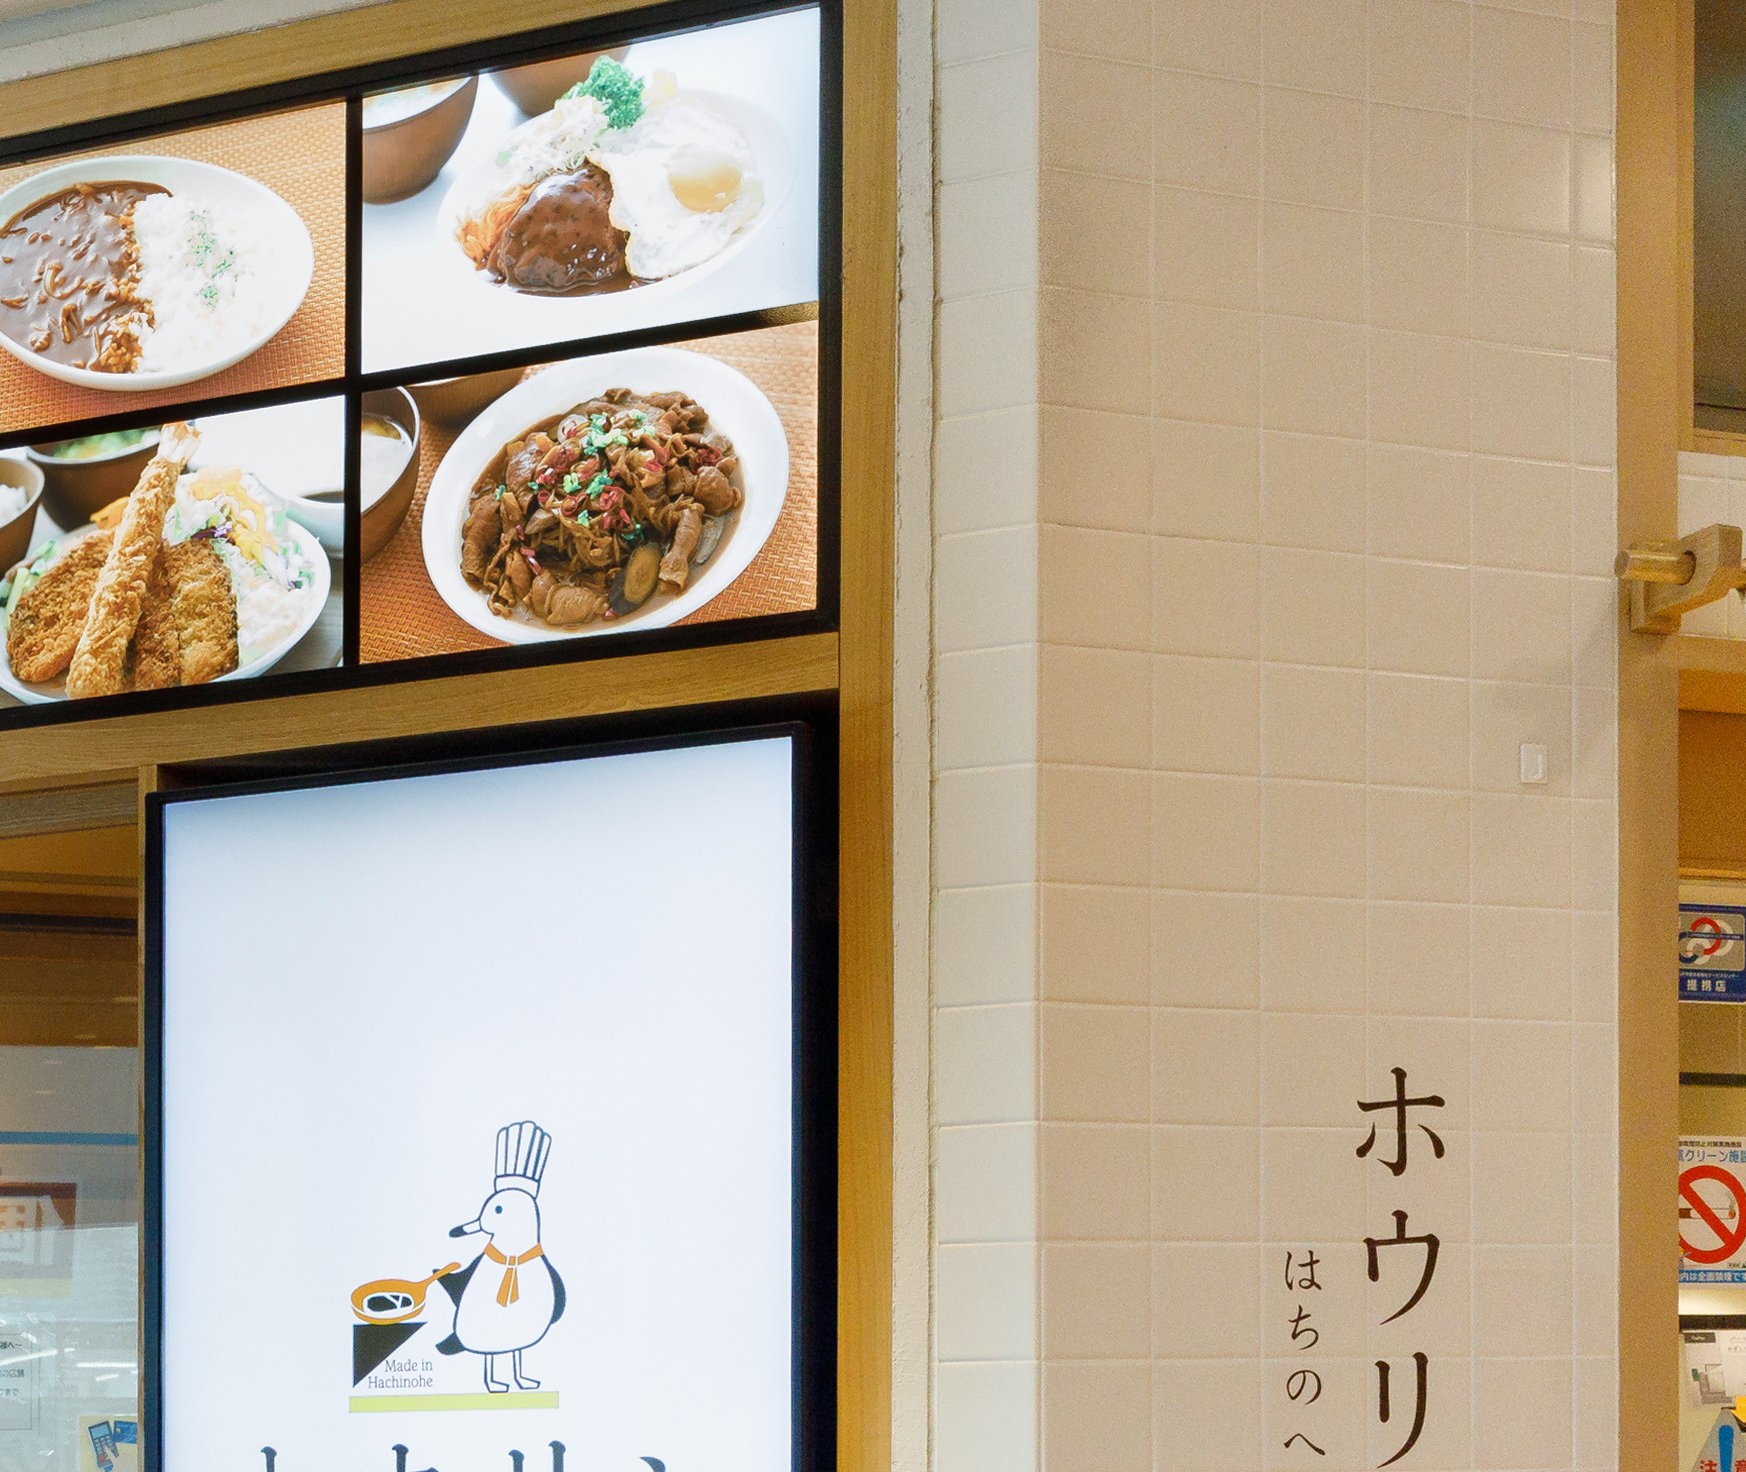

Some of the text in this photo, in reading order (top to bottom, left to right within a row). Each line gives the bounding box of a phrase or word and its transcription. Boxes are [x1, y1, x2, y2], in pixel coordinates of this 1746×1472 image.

[383, 1358, 434, 1375] Made in
[366, 1373, 434, 1391] Hachinohe
